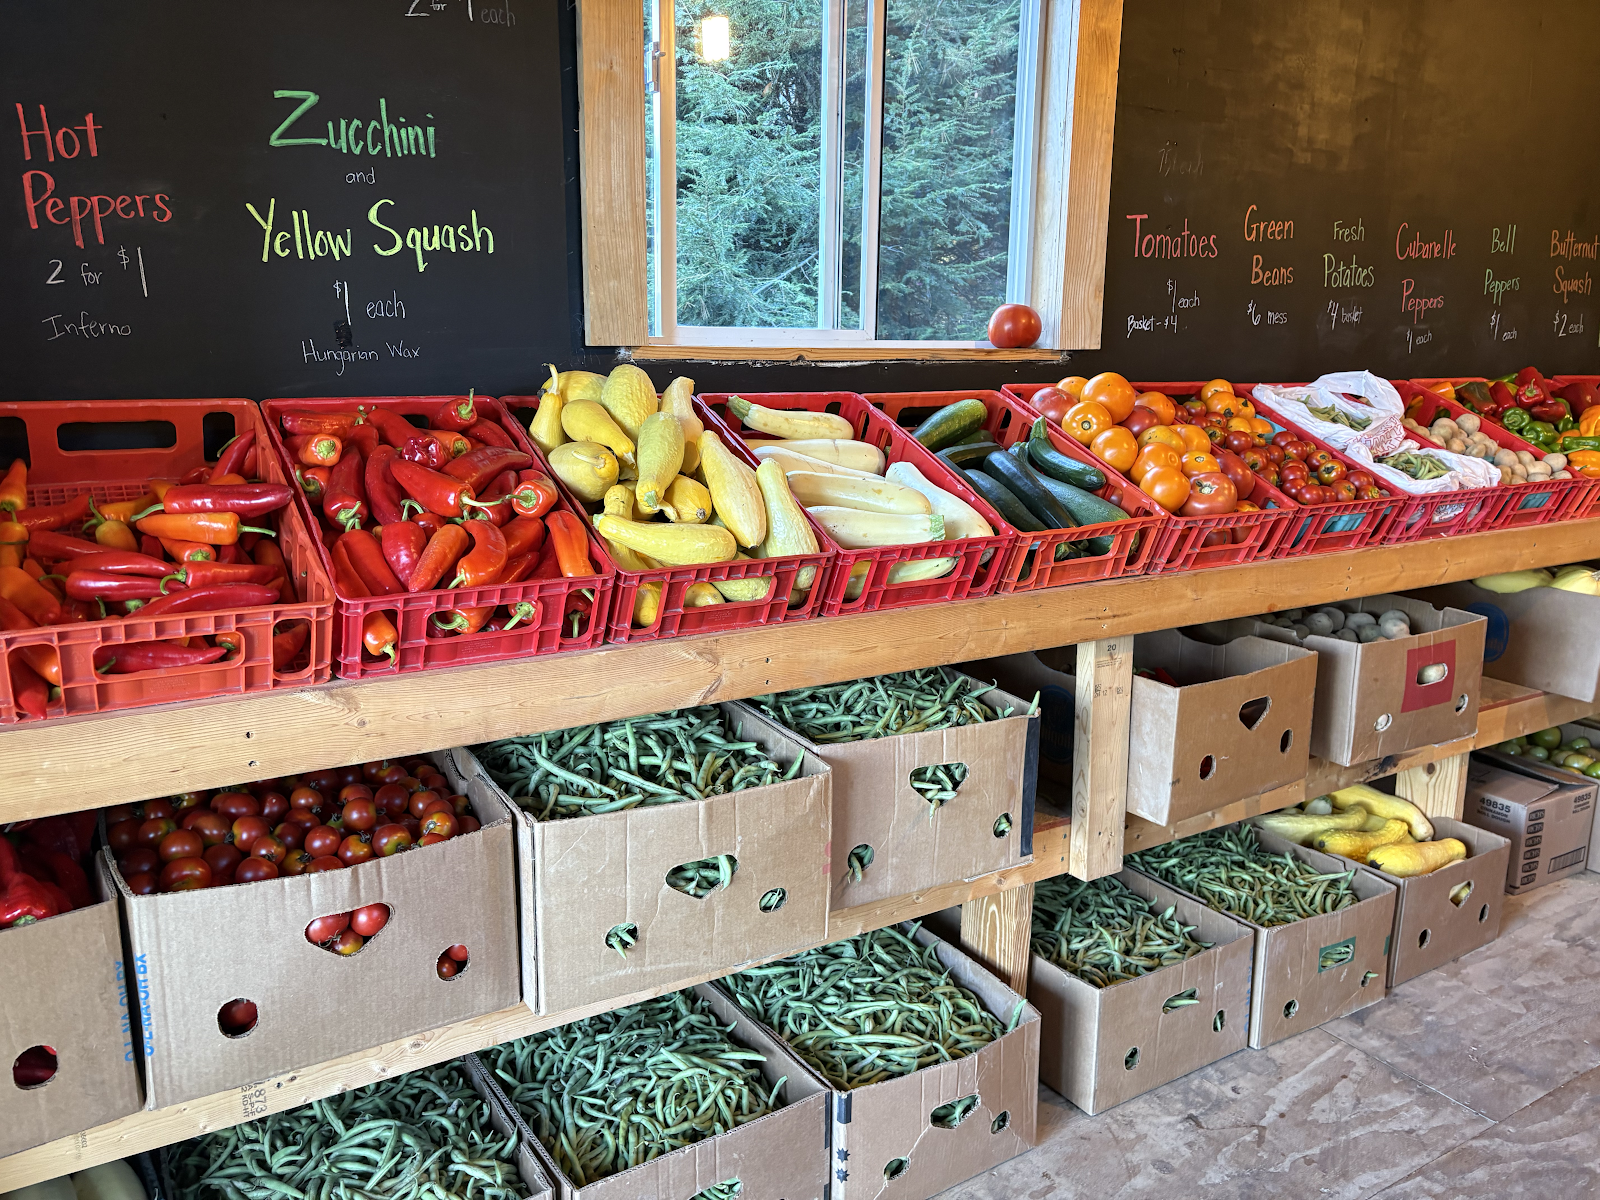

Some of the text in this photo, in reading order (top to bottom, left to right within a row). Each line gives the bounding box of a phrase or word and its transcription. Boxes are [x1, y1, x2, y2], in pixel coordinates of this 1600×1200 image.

[480, 0, 516, 27] each
[15, 102, 103, 162] Hot
[269, 89, 437, 158] Zucchini
[345, 166, 377, 185] and
[21, 169, 173, 249] Peppers
[1244, 203, 1294, 242] Green
[245, 197, 495, 272] Yellow Squash
[1126, 213, 1219, 260] Tomatoes
[1333, 217, 1366, 243] Fresh
[1395, 221, 1457, 261] Cubanelle
[1490, 223, 1518, 255] Bell
[1549, 229, 1600, 261] Butternut
[45, 244, 149, 299] 2 for $1
[1250, 254, 1294, 287] Beans
[1322, 252, 1376, 288] Potatoes
[1552, 265, 1593, 305] Squash
[332, 279, 407, 326] $1 each
[1177, 289, 1201, 309] each
[1401, 277, 1446, 325] Peppers
[1483, 267, 1522, 307] Peppers
[40, 310, 133, 342] Inferno
[1246, 299, 1289, 326] $6 mess
[1326, 299, 1340, 331] $4
[1552, 309, 1585, 338] $2 each
[1415, 329, 1434, 346] each
[1501, 327, 1519, 342] each
[301, 338, 421, 377] Hungarian Wax
[1107, 643, 1117, 652] 20
[1479, 797, 1511, 813] 49835
